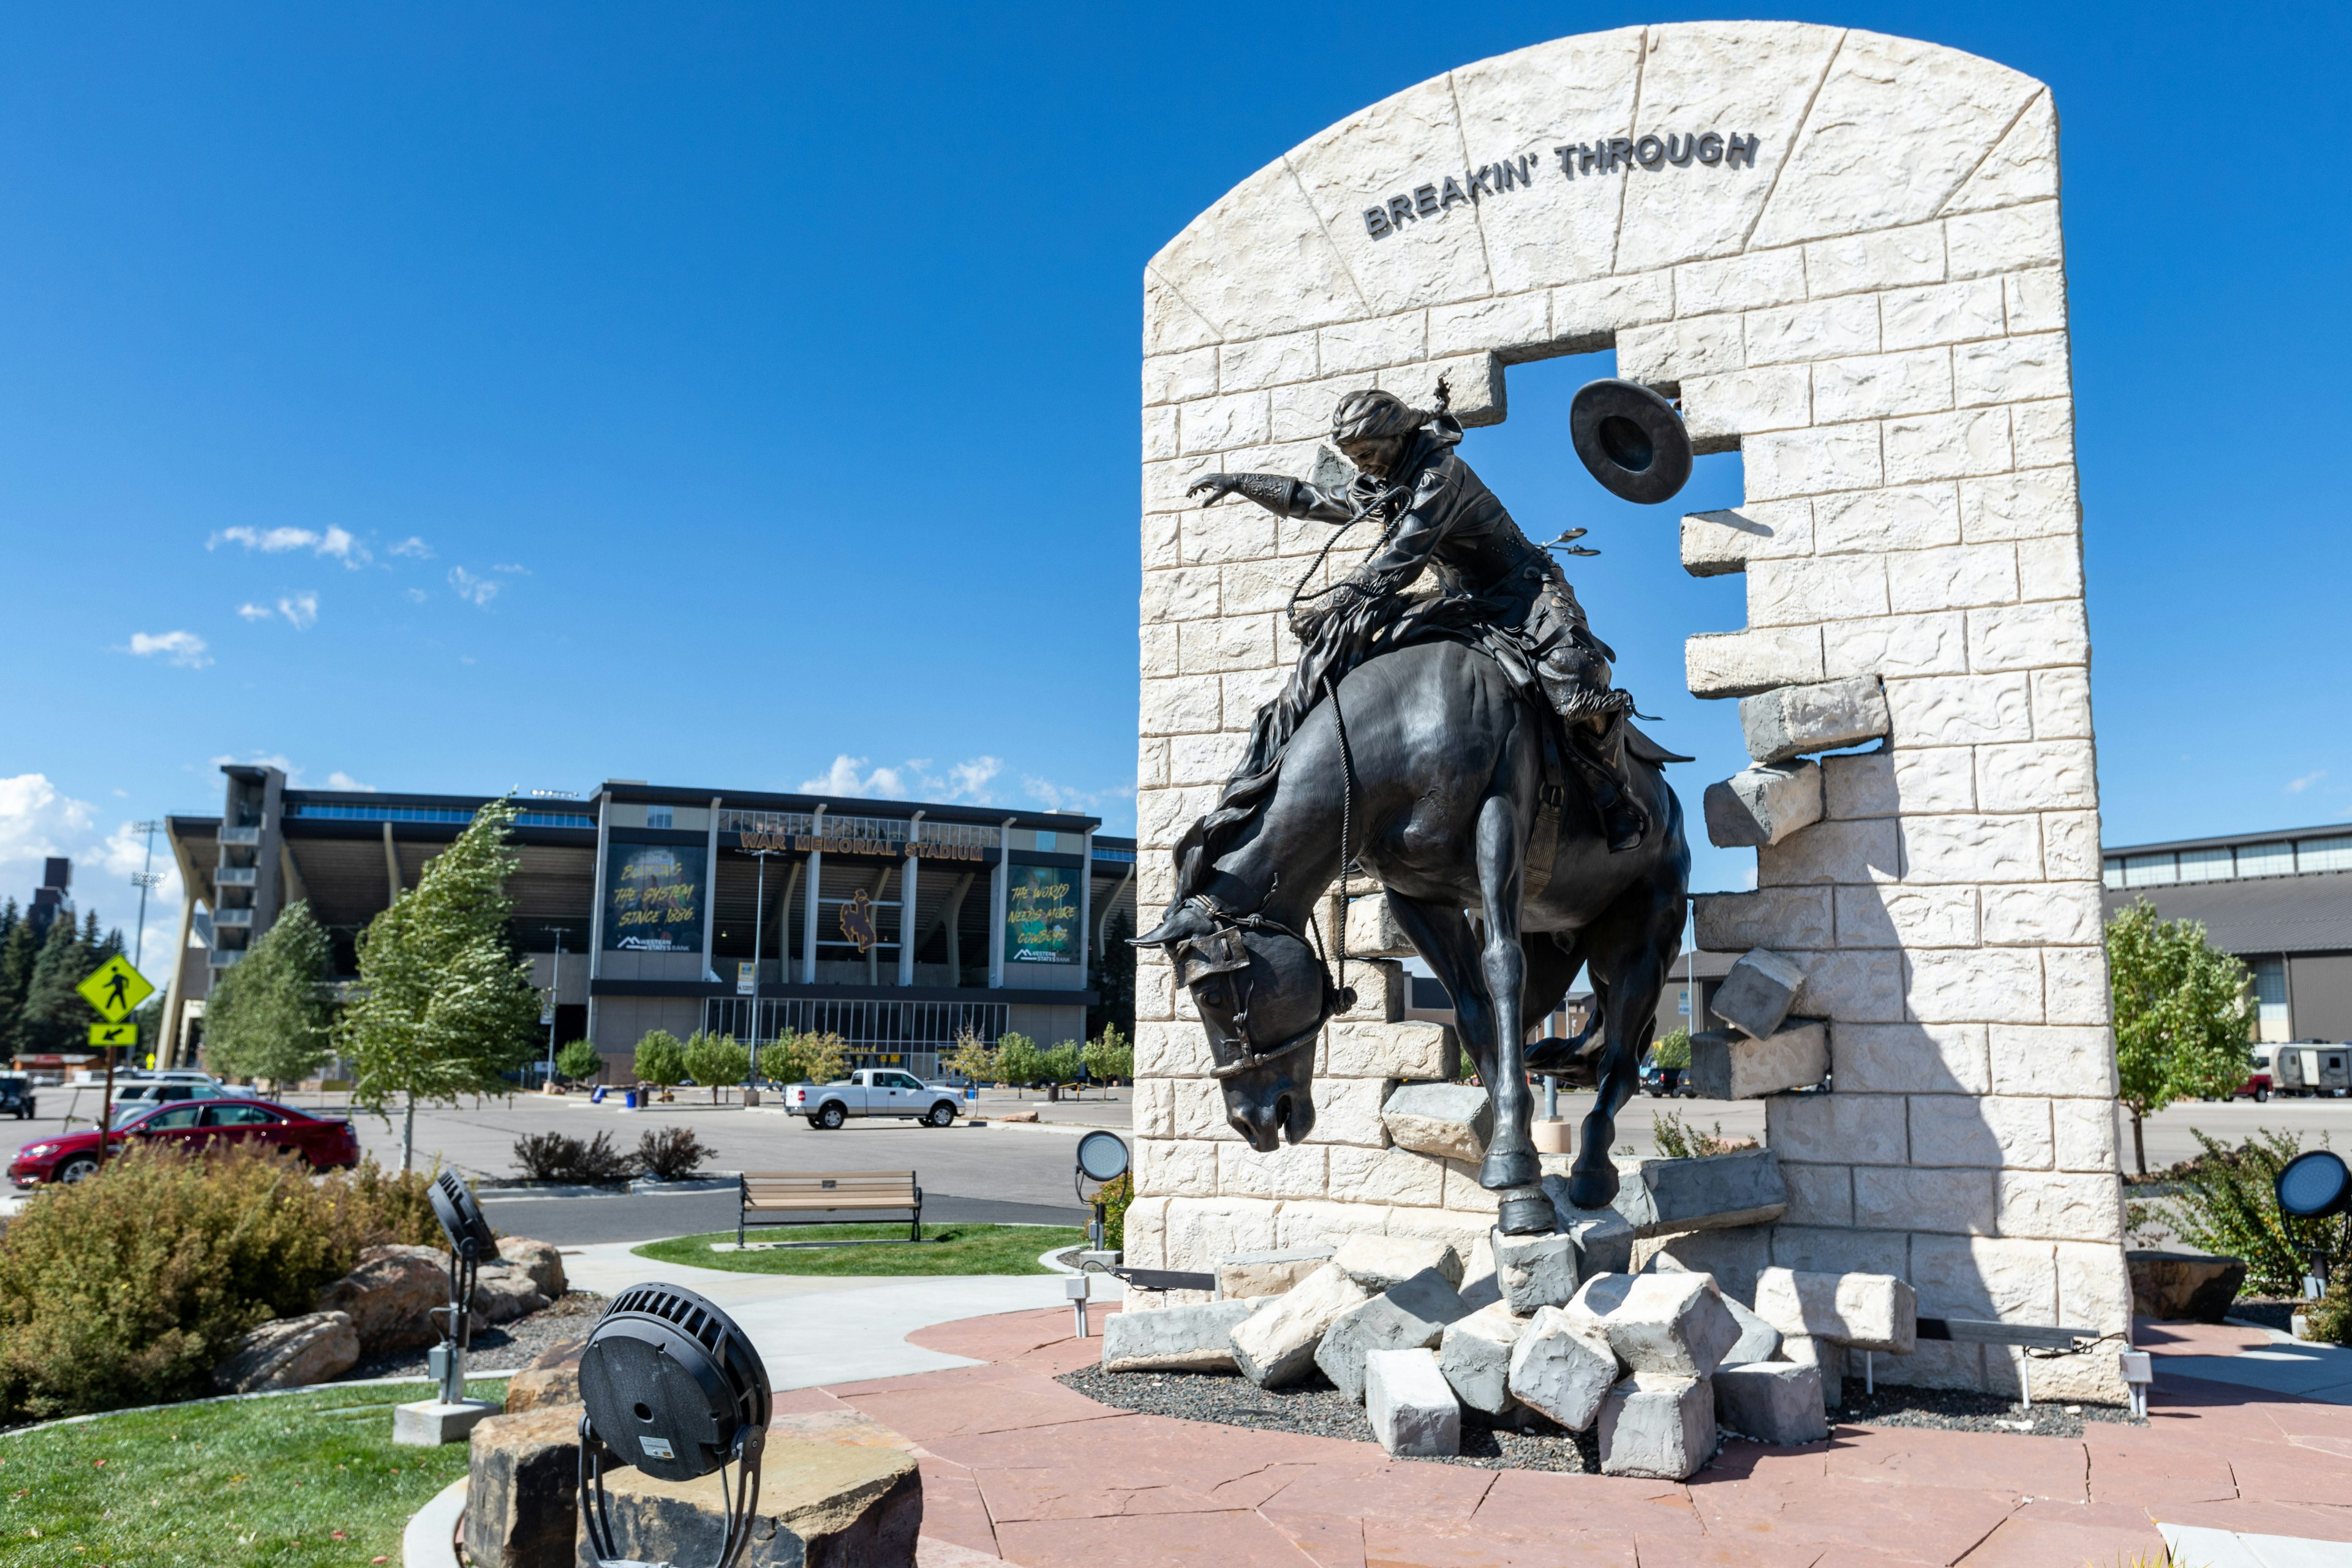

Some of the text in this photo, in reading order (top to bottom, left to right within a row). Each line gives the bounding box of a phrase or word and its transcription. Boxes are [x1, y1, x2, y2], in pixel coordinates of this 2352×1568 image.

[1362, 132, 1757, 236] BREAKIN' THROUGH
[741, 833, 983, 861] WAR MEMORIAL STADIUM
[614, 883, 694, 909] THE SYSTEM
[1011, 883, 1070, 905] THE WORLD
[619, 908, 661, 927] SINCE
[1008, 907, 1077, 923] NEEDS MORE
